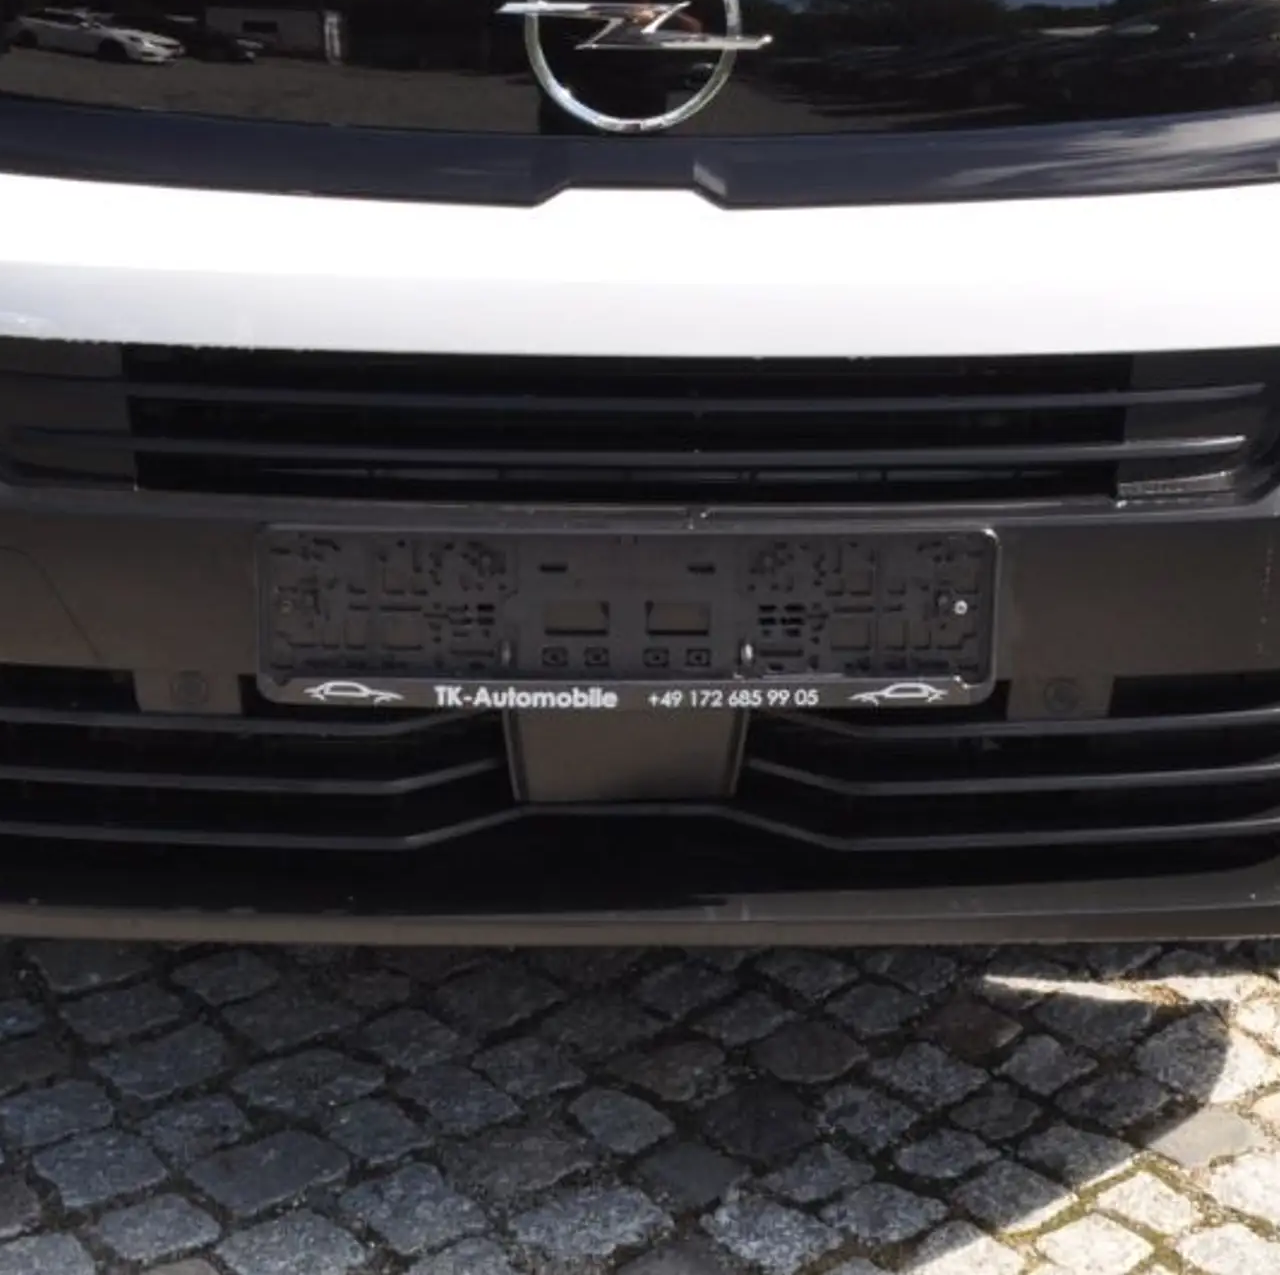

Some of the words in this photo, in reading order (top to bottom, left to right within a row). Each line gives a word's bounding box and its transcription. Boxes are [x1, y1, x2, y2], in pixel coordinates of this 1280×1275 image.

[434, 684, 618, 708] TK-Automobile
[648, 689, 682, 707] +49
[691, 689, 723, 707] 172
[728, 689, 762, 707] 685
[766, 689, 790, 707] 99
[794, 689, 819, 707] 05
